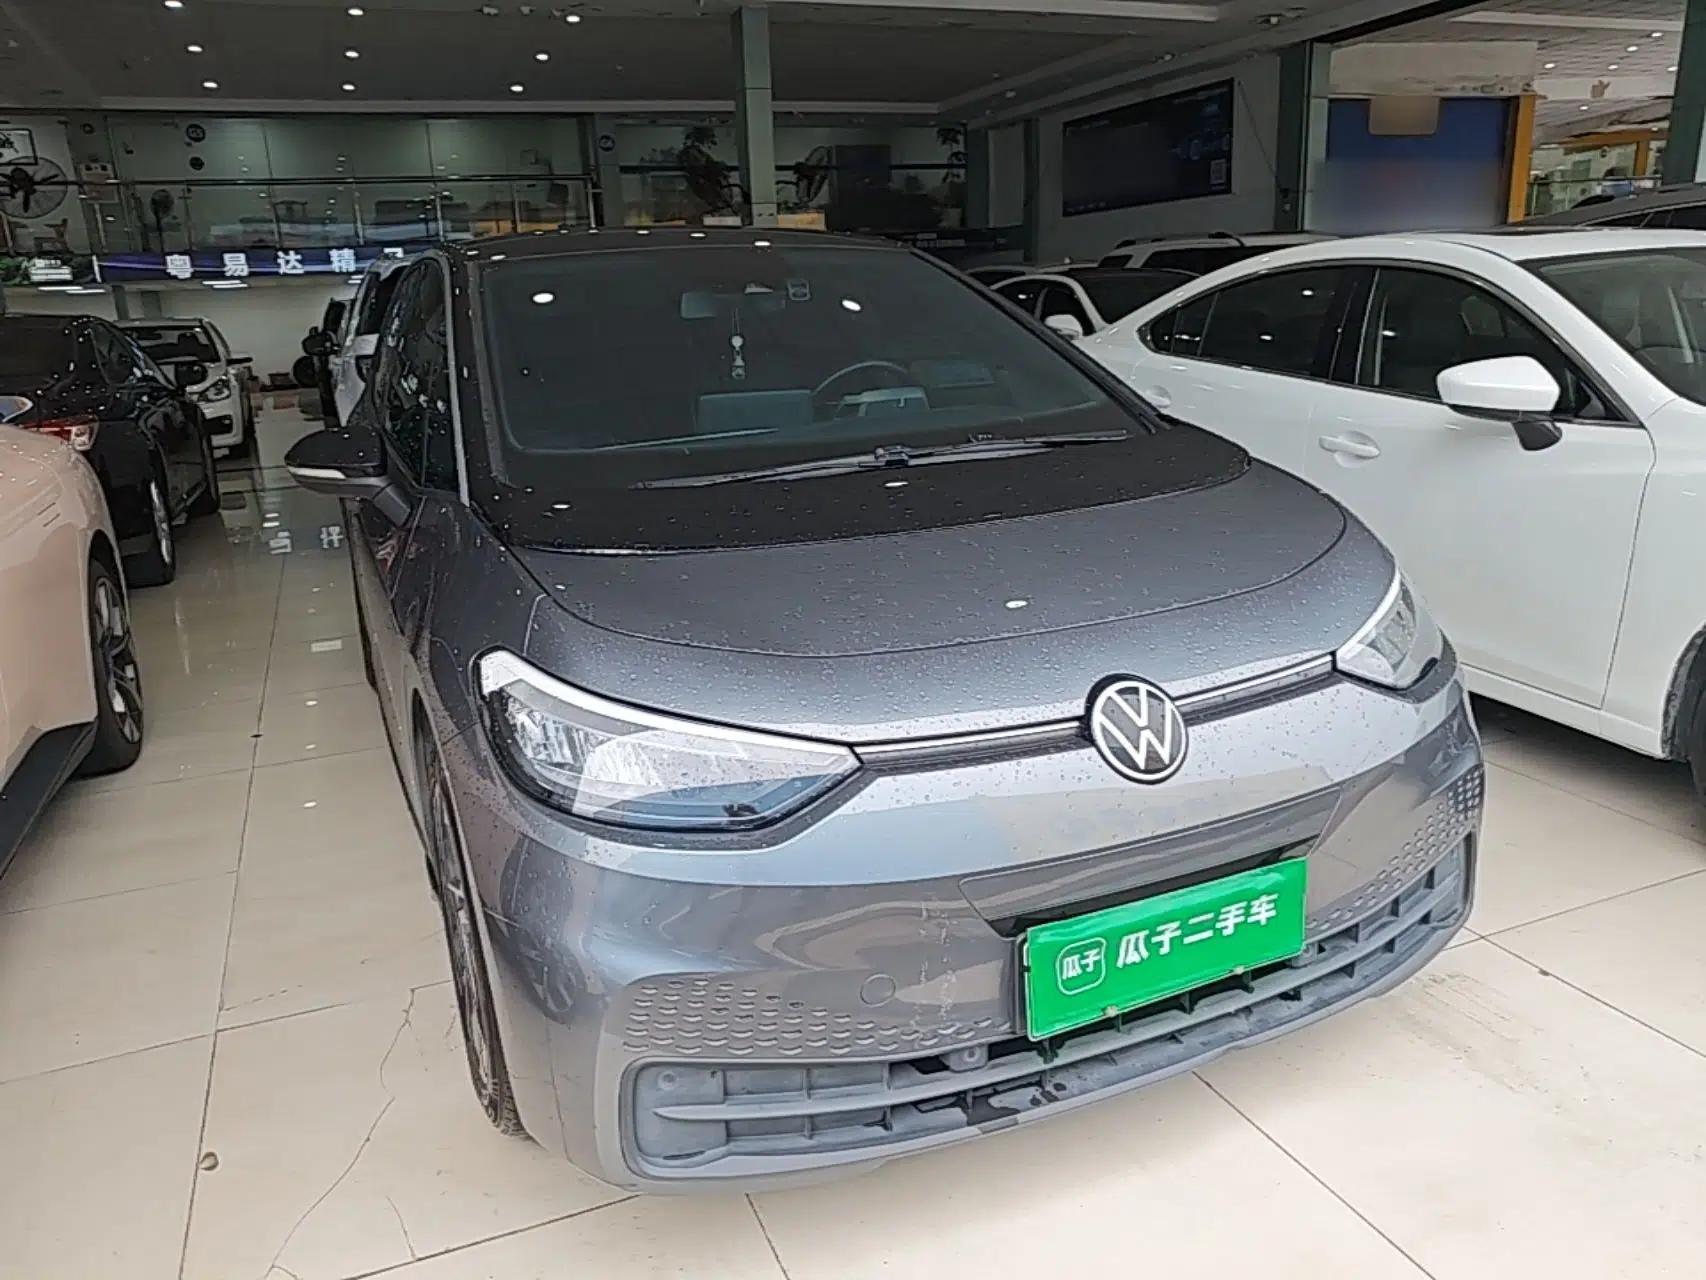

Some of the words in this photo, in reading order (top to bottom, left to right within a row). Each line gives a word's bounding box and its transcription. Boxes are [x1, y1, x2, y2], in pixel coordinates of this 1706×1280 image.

[1116, 894, 1278, 968] 瓜子二手车
[1062, 948, 1101, 980] 瓜子
